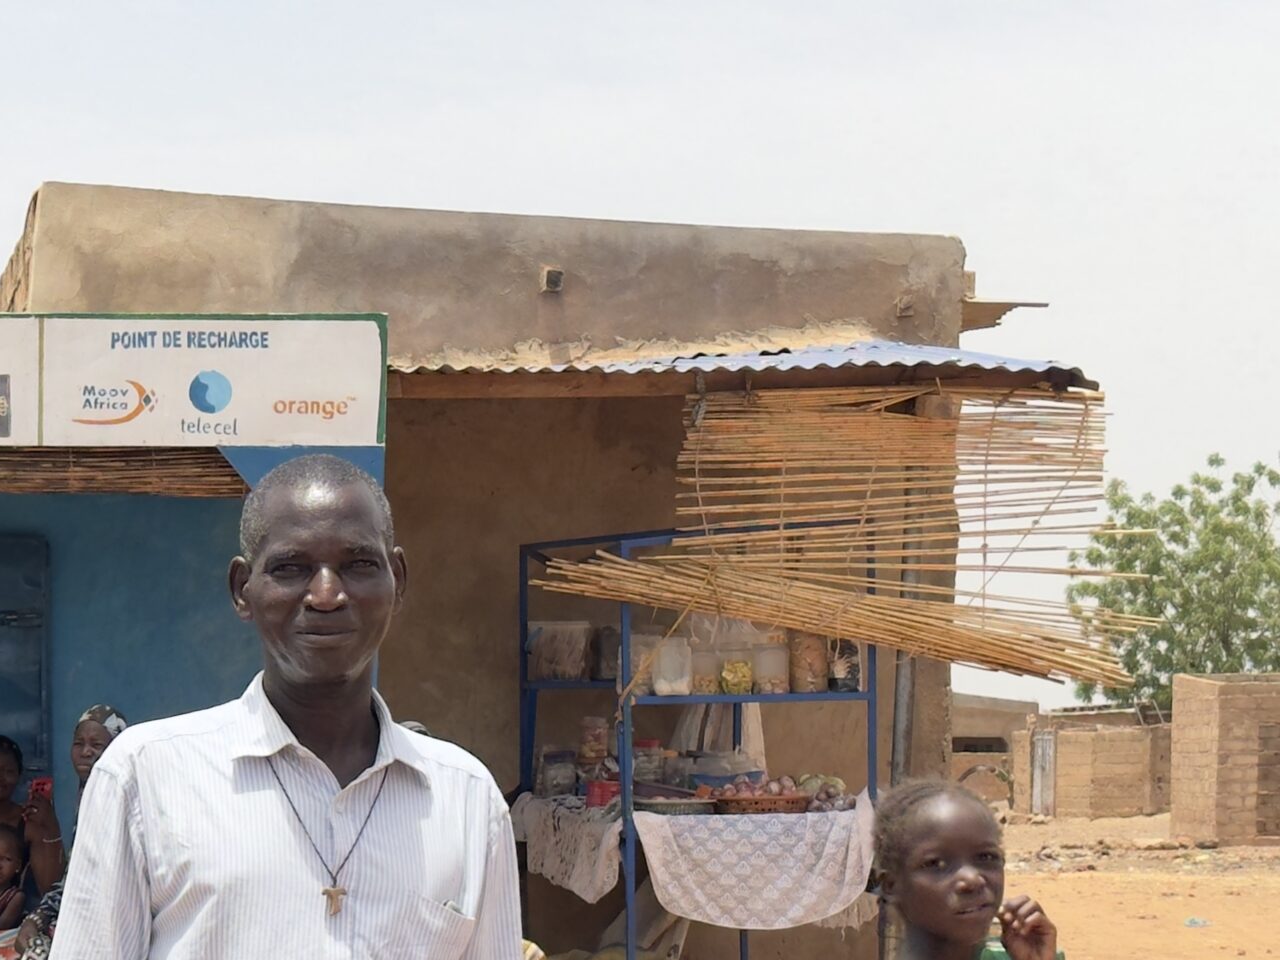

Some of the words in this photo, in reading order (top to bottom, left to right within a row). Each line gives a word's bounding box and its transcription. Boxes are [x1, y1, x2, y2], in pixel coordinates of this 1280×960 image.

[111, 331, 157, 349] POINT
[162, 331, 181, 349] DE
[187, 331, 269, 349] RECHARGE
[82, 385, 128, 398] Moov
[82, 397, 128, 411] Africa
[181, 417, 238, 436] telecel
